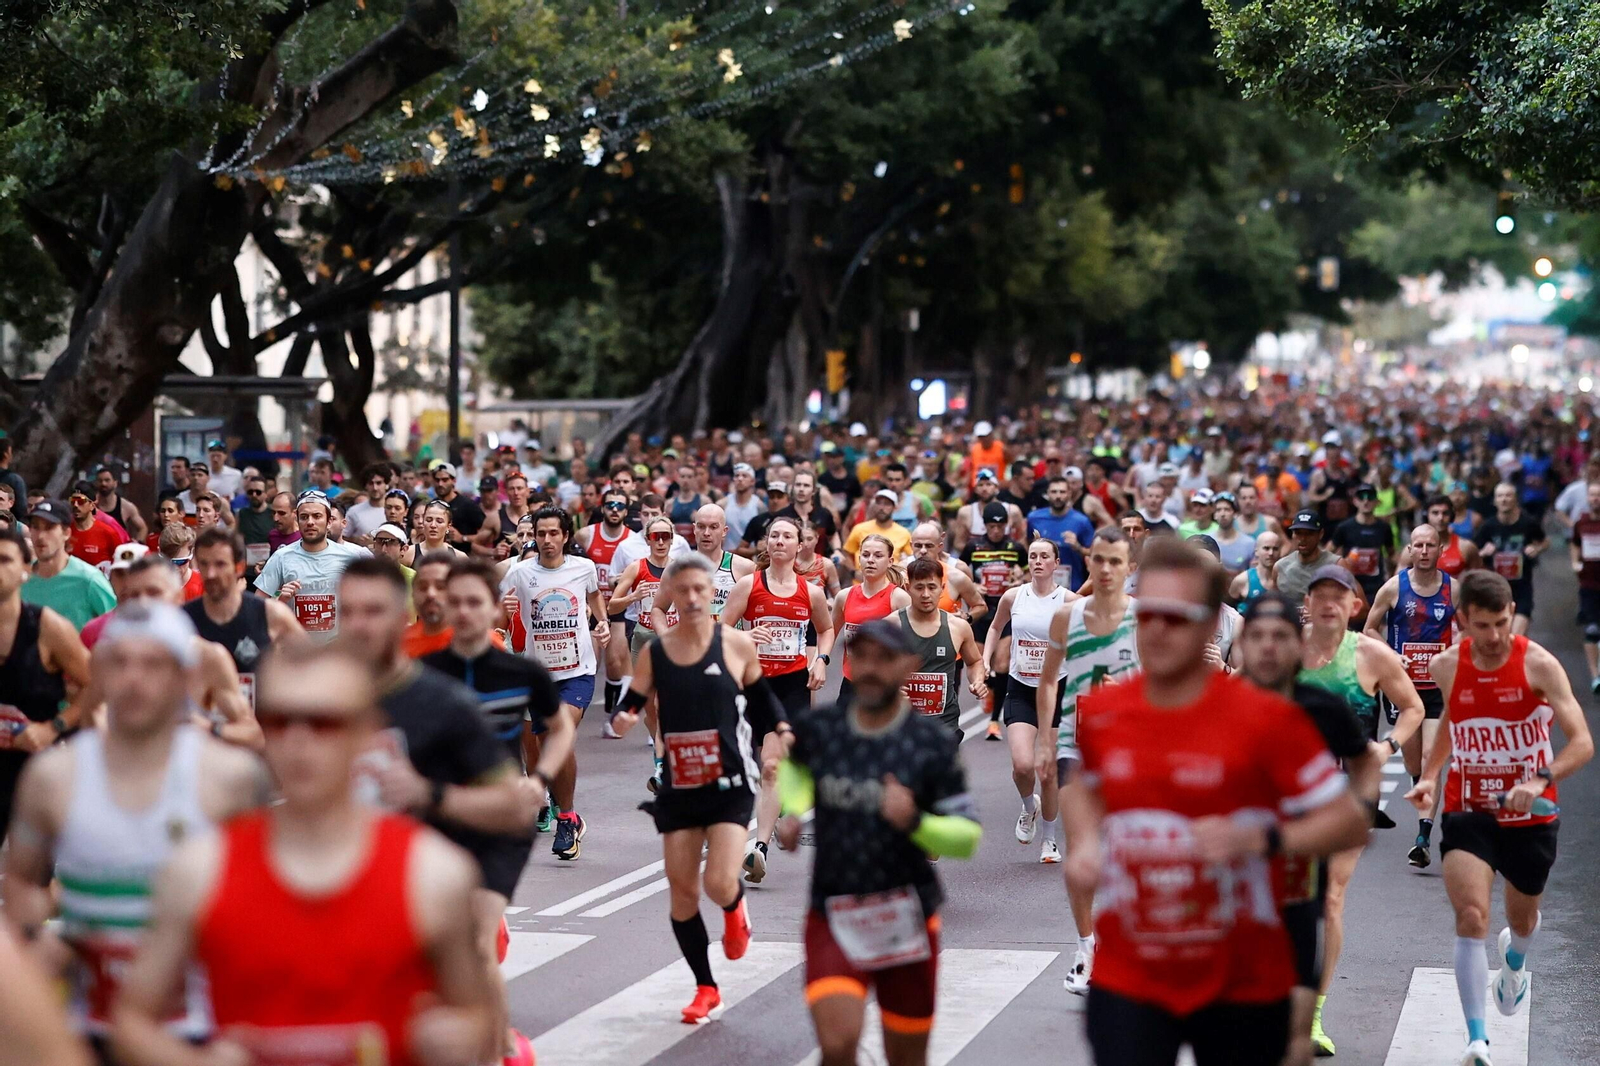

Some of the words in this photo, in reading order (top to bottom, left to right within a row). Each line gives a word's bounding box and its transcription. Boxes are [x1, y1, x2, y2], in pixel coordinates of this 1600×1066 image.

[542, 642, 568, 651] 15152
[1412, 653, 1433, 661] 2697
[908, 683, 936, 692] 11552
[1480, 778, 1504, 790] 350
